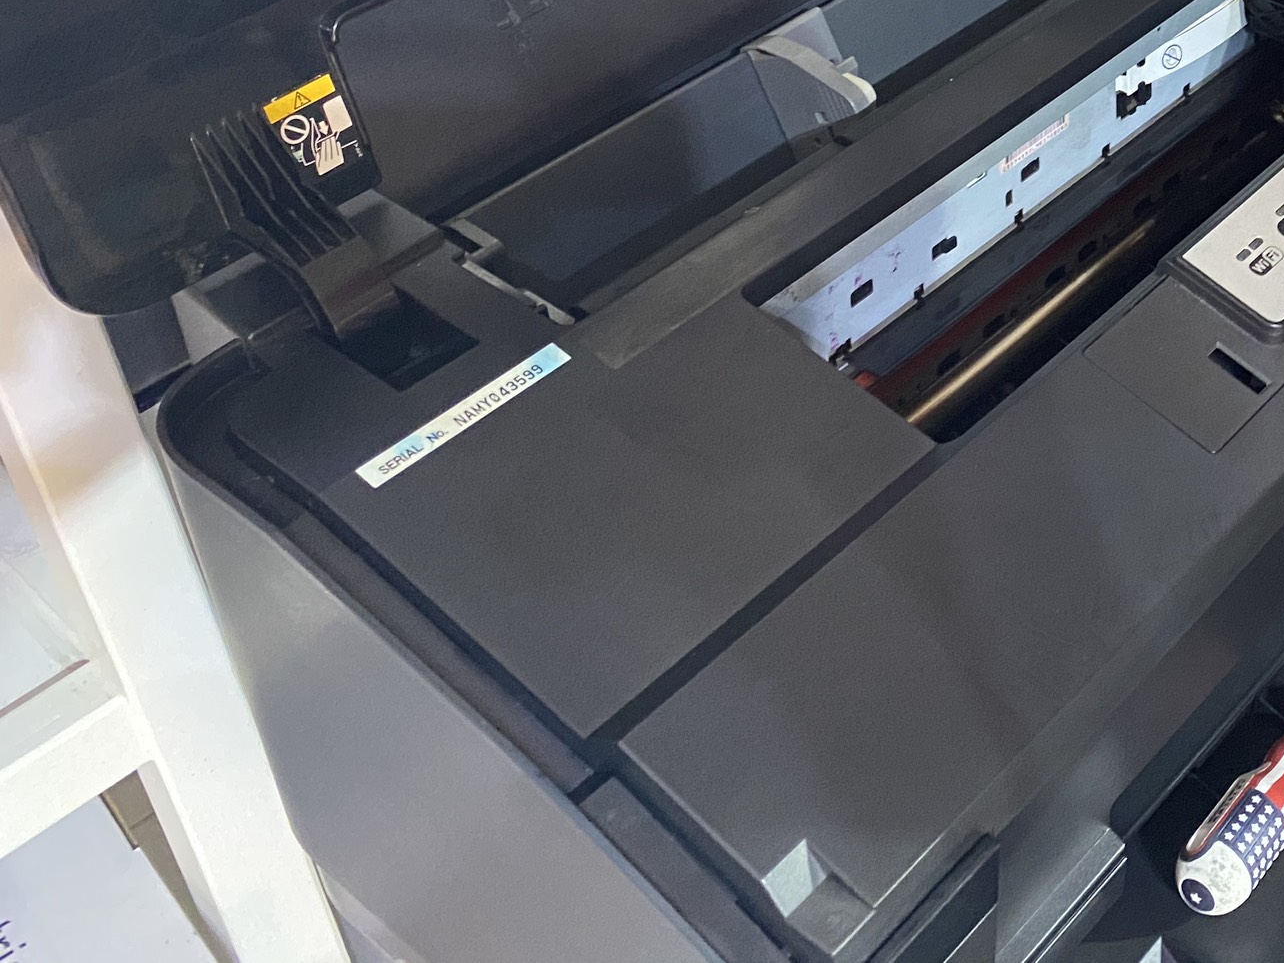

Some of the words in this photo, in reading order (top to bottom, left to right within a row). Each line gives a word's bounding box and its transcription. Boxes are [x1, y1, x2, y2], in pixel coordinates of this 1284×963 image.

[378, 445, 423, 475] SERIAL
[426, 429, 449, 444] No.
[453, 364, 544, 427] NAMY043599
